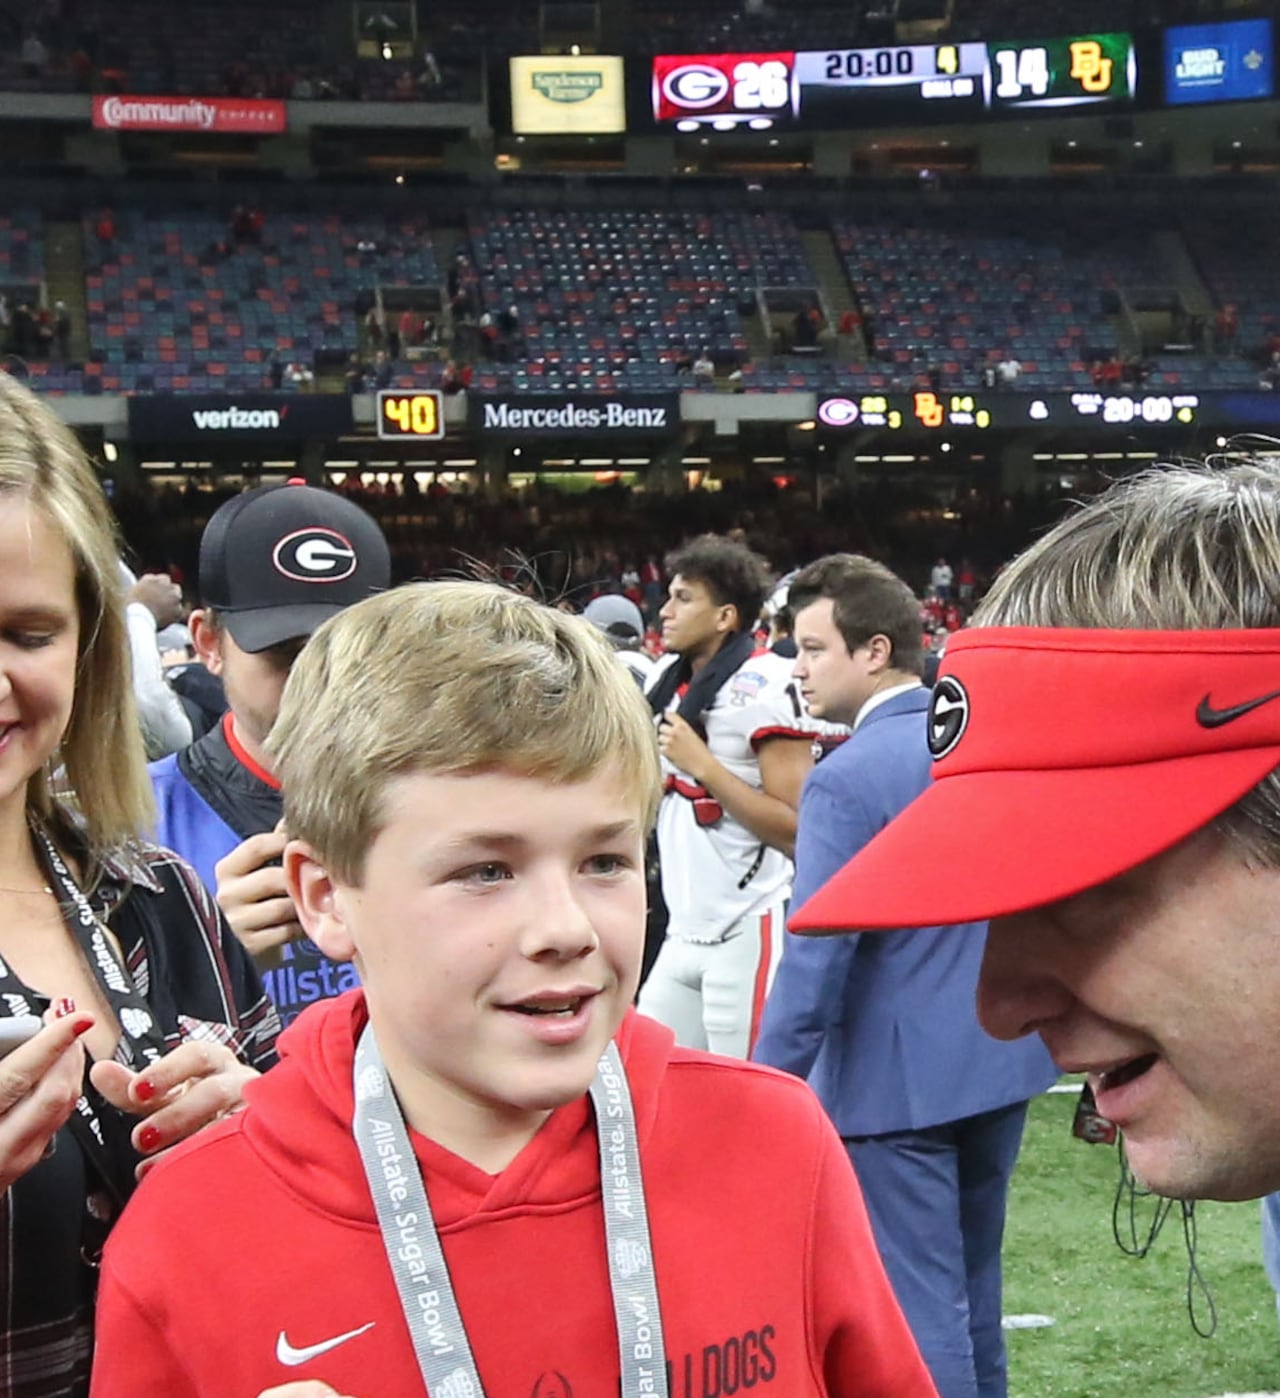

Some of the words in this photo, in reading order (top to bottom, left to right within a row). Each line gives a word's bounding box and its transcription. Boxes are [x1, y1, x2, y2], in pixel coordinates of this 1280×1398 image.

[826, 50, 913, 79] 20:00
[996, 48, 1048, 97] 14
[733, 61, 788, 109] 26
[102, 96, 216, 128] Community
[193, 406, 280, 429] verizon
[385, 396, 436, 434] 40
[483, 402, 667, 428] Mercedes-Benz
[1103, 396, 1173, 422] 20:00
[282, 531, 357, 578] G
[395, 1211, 432, 1285] Sugar
[418, 1289, 455, 1356] Bowl
[627, 1296, 652, 1361] Bowl
